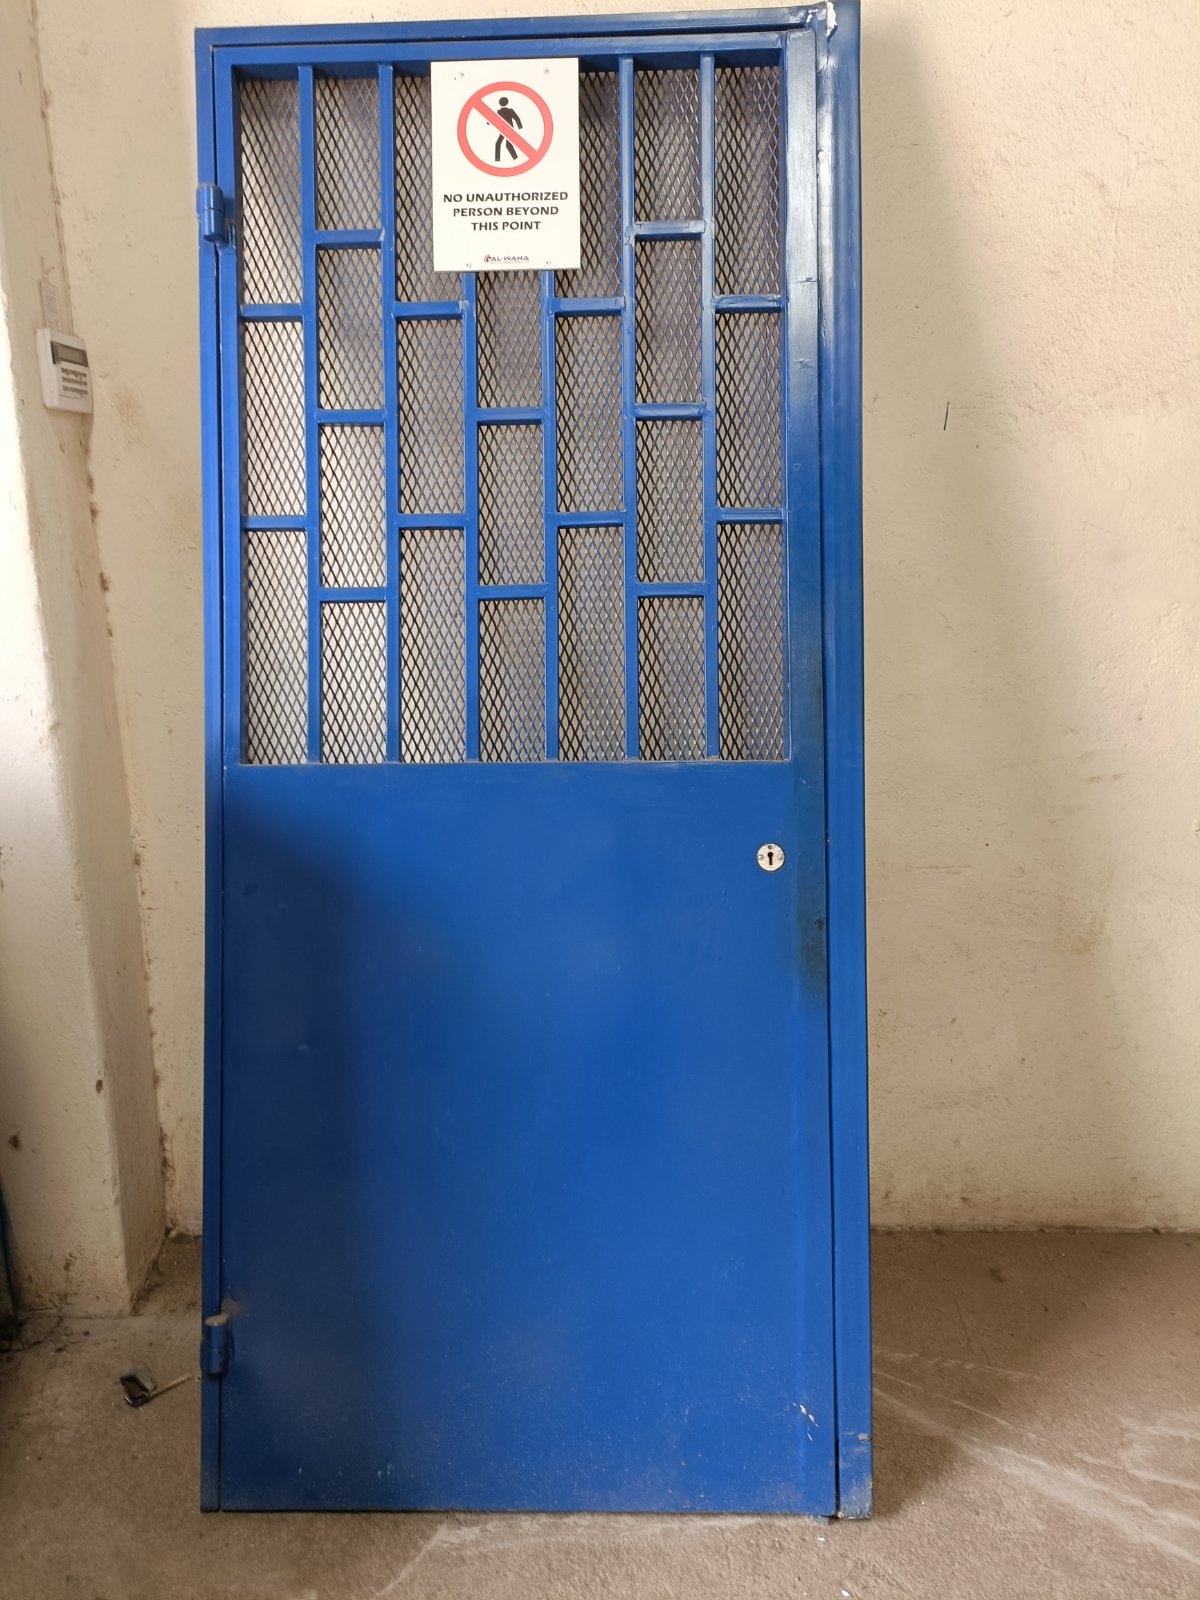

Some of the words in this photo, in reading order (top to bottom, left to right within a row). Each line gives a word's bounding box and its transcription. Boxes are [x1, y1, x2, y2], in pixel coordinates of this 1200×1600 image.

[443, 194, 463, 203] NO
[466, 191, 568, 202] UNAUTHORIZED
[453, 207, 503, 217] PERSON
[506, 206, 559, 216] BEYOND
[471, 222, 499, 231] THIS
[502, 221, 541, 230] POINT
